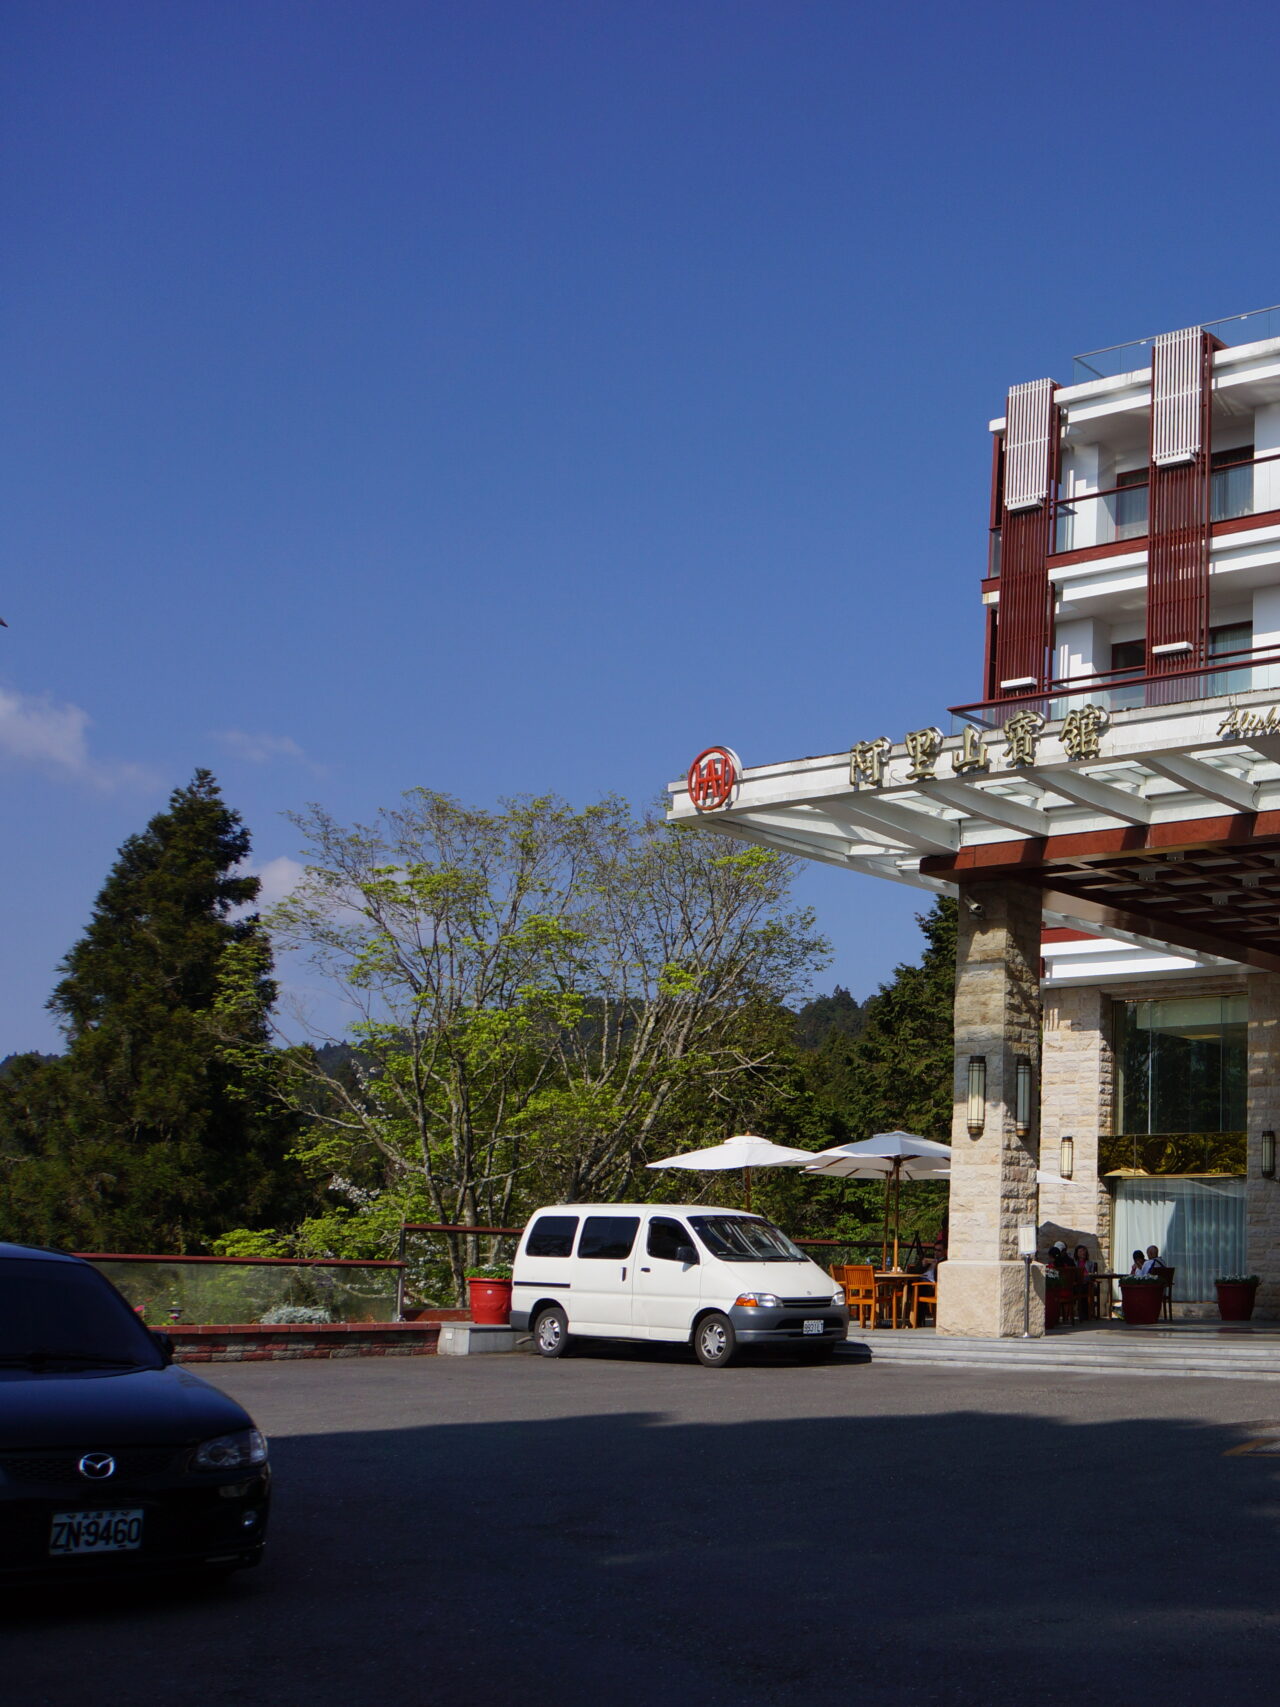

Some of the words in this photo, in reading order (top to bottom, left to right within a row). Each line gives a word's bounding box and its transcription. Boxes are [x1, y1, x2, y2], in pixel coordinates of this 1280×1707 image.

[849, 704, 1106, 786] 阿里山賓館
